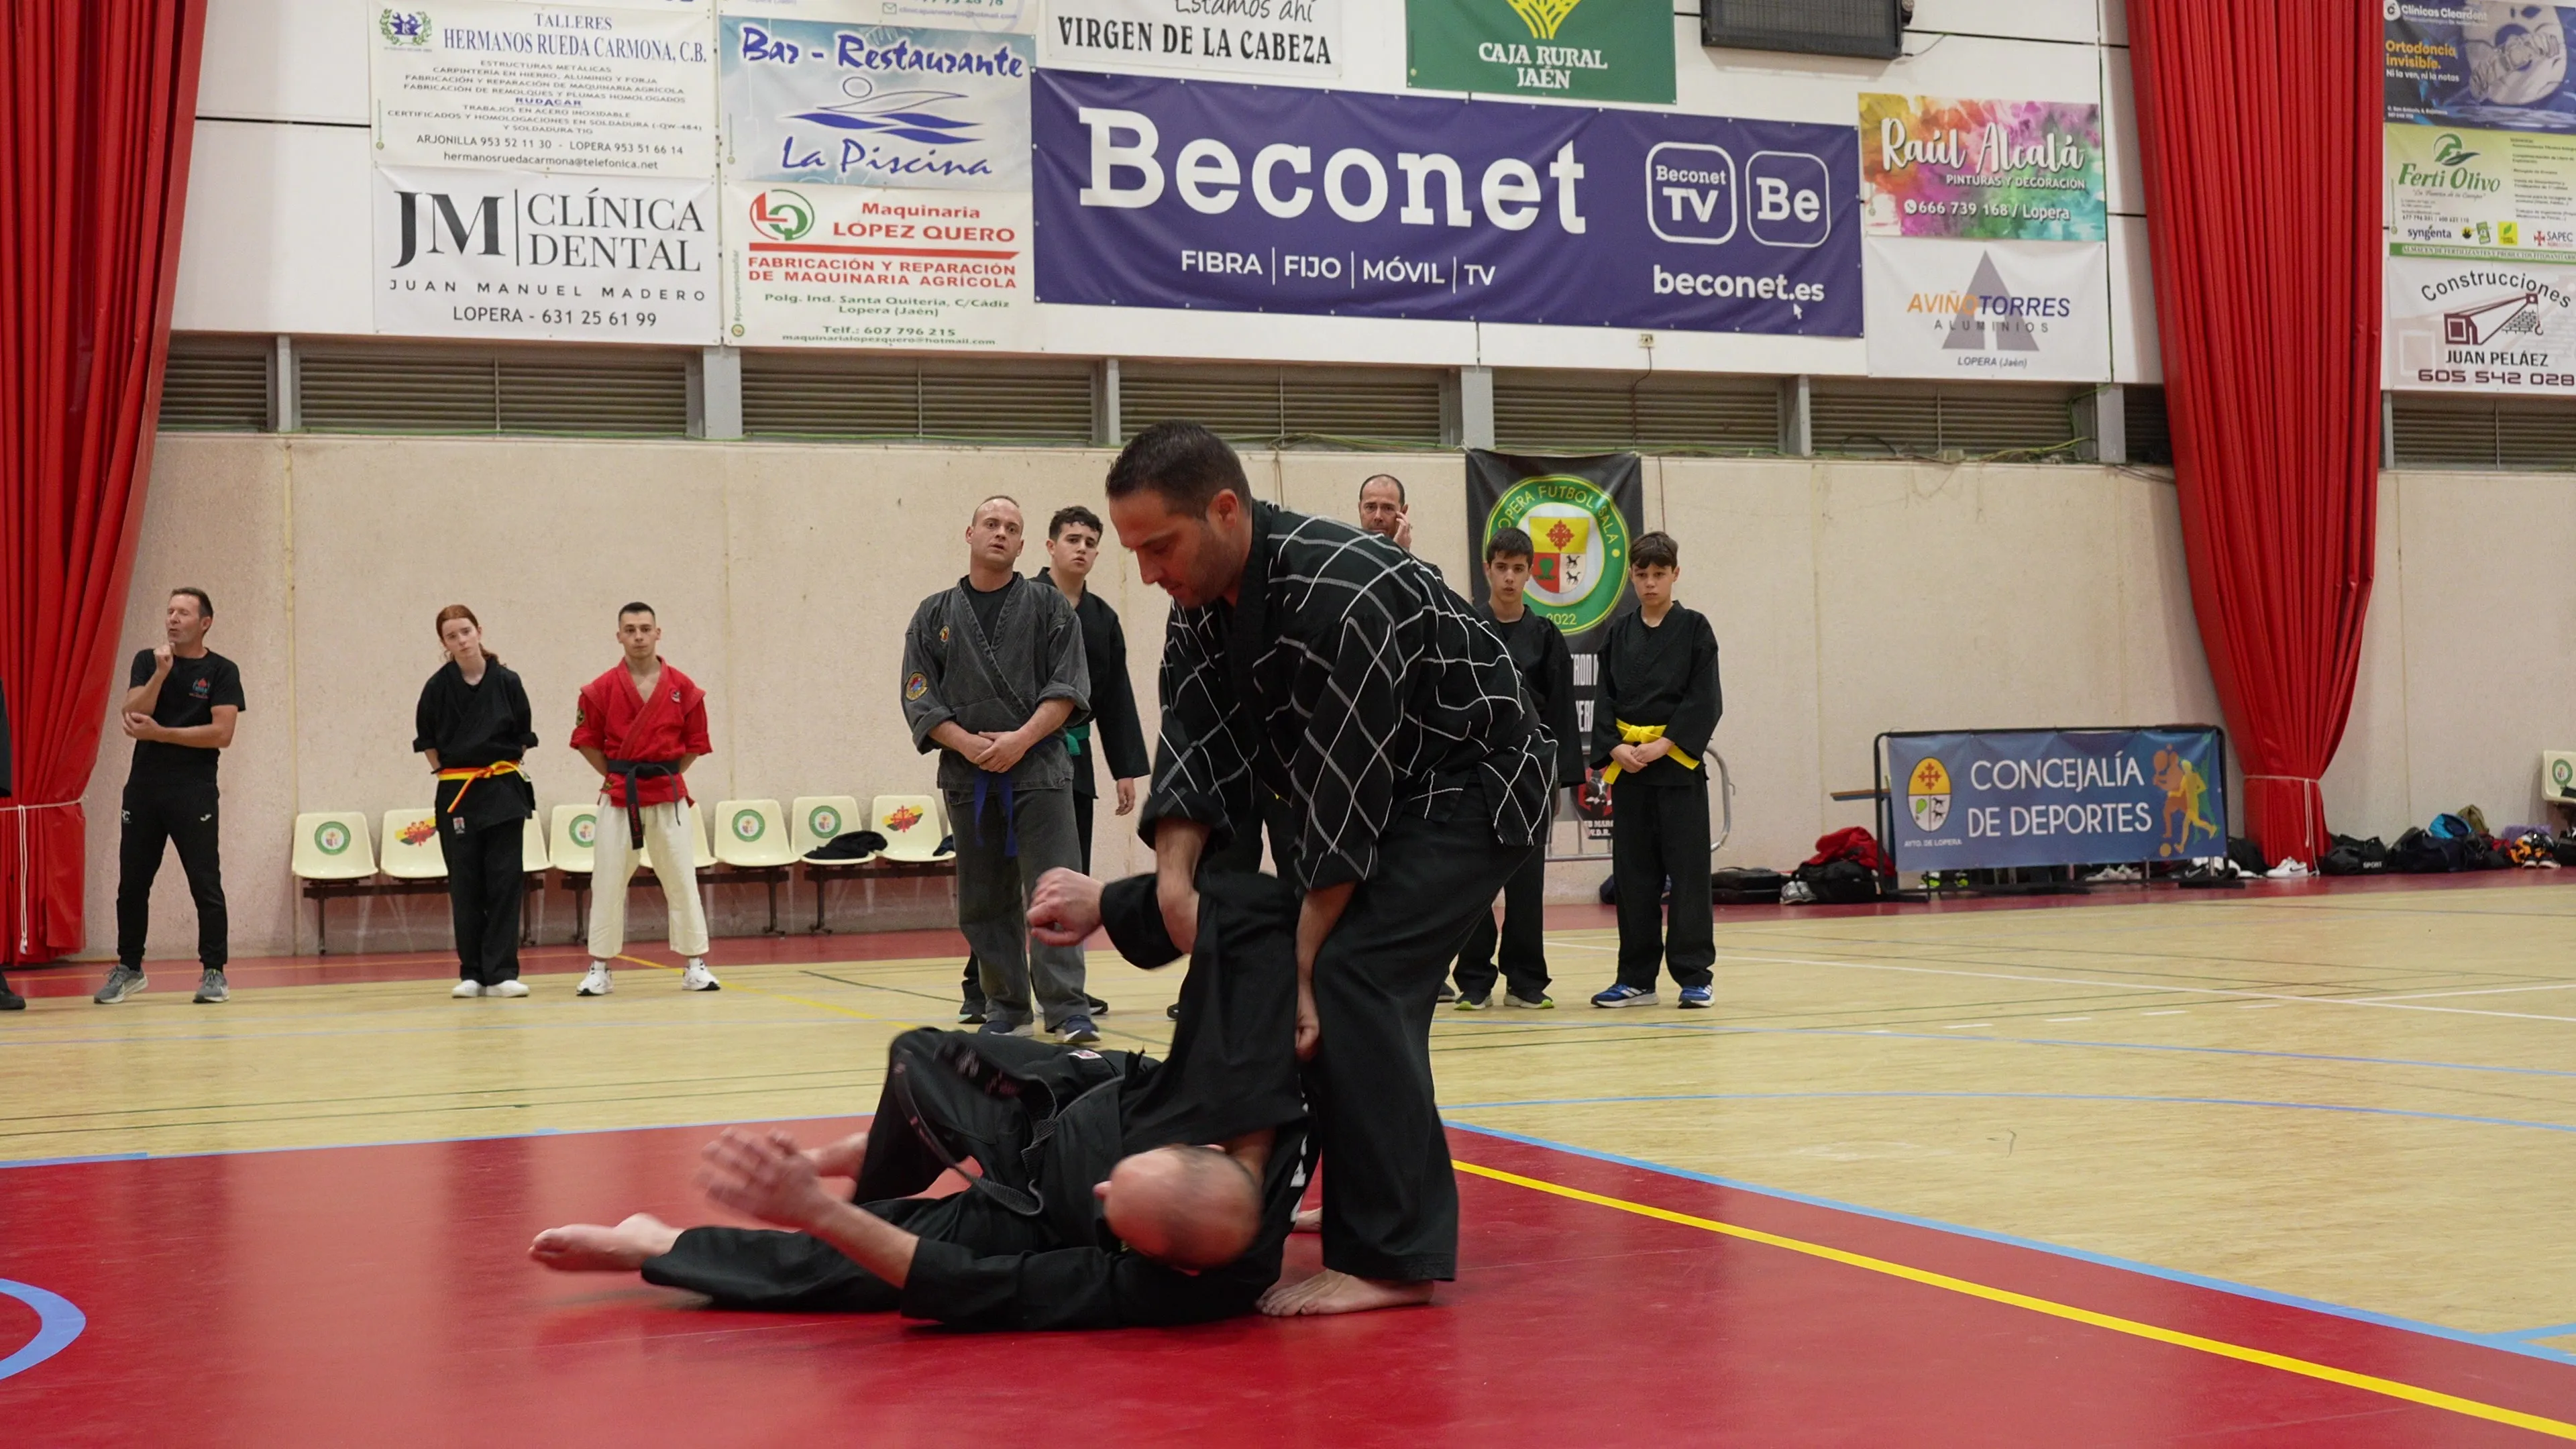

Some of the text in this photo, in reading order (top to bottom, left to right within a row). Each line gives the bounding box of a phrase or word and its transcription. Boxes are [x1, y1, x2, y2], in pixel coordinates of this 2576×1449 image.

[534, 13, 612, 30] TALLERES
[444, 29, 706, 63] HERMANOS RUEDA CARMONA, C.B.
[1059, 16, 1332, 64] VIRGEN DE LA CABEZA
[742, 27, 1023, 78] Bar Restaurante
[1479, 42, 1608, 69] CAJA RURAL
[2386, 53, 2441, 69] invisible.
[480, 60, 553, 70] ESTRUCTURAS
[564, 74, 612, 82] ALUMINIO
[1517, 65, 1571, 89] JAÉN
[2386, 68, 2395, 77] Ni
[2396, 70, 2404, 78] la
[2421, 71, 2428, 79] ni
[2429, 72, 2436, 80] la
[2438, 74, 2460, 82] notas
[492, 88, 553, 97] REMOLQUES
[609, 94, 686, 103] HOMOLOGADOS
[570, 83, 633, 92] MAQUINARIA
[463, 104, 515, 113] TRABAJOS
[515, 97, 582, 106] RUDACAR
[388, 110, 462, 119] CERTIFICADOS
[474, 115, 570, 125] HOMOLOGACIONES
[590, 120, 649, 128] SOLDADURA
[513, 125, 574, 133] SOLDADURA
[417, 134, 684, 154] ARJONILLA 953 52 11 30 LOPERA 953 51 66 14
[1880, 117, 2084, 174] Raúl Alcalá
[443, 151, 659, 169] hermanosruedacarmona@telefonica.net
[782, 136, 993, 175] La Piscina
[1078, 106, 1586, 235] Beconet
[1656, 165, 1726, 185] Beconet
[2398, 162, 2501, 193] Ferti Olivo
[1945, 174, 2086, 190] PINTURAS Y DECORACIÓN
[1662, 186, 1719, 223] TV
[1756, 176, 1821, 223] Be
[527, 187, 705, 232] CLÍNICA
[862, 203, 980, 219] Maquinaria
[1918, 202, 2071, 221] 666 739 168 / Lopera
[390, 190, 506, 268] JM
[922, 225, 1015, 243] QUERO
[2408, 227, 2452, 241] syngenta
[2547, 231, 2573, 242] SAPEC
[529, 233, 701, 272] DENTAL
[748, 256, 1016, 276] FABRICACIÓN Y REPARACIÓN
[1181, 249, 1495, 286] FIBRA FIJO MÓVIL TV
[749, 270, 1017, 288] DE MAQUINARIA AGRÍCOLA
[1653, 264, 1825, 301] beconet.es
[389, 280, 706, 301] JUAN MANUEL MADERO
[2422, 270, 2571, 308] Construcciones
[765, 293, 802, 304] Polg.
[807, 294, 835, 303] Ind.
[839, 295, 881, 305] Santa
[885, 296, 950, 307] Quiteria,
[1907, 290, 2071, 317] AVIÑOTORRES
[453, 306, 657, 327] LOPERA 631 25 61 99
[838, 305, 939, 317] Lopera (Jaén)
[822, 325, 956, 336] Telf.: 607 796 215
[1933, 319, 2049, 333] ALUMINIOS
[782, 333, 996, 345] maquinarialopezquero@hotmail.com
[1957, 356, 2028, 369] LOPERA (Jaén)
[2445, 350, 2548, 367] JUAN PELÁEZ
[2418, 369, 2575, 386] 605 542 028
[1497, 485, 1619, 544] OPERA FUTBOL SALA
[1546, 613, 1576, 625] 2022
[1970, 750, 2145, 793] CONCEJALÍA
[1968, 802, 2152, 838] DE DEPORTES
[1934, 838, 1963, 847] LOPERA
